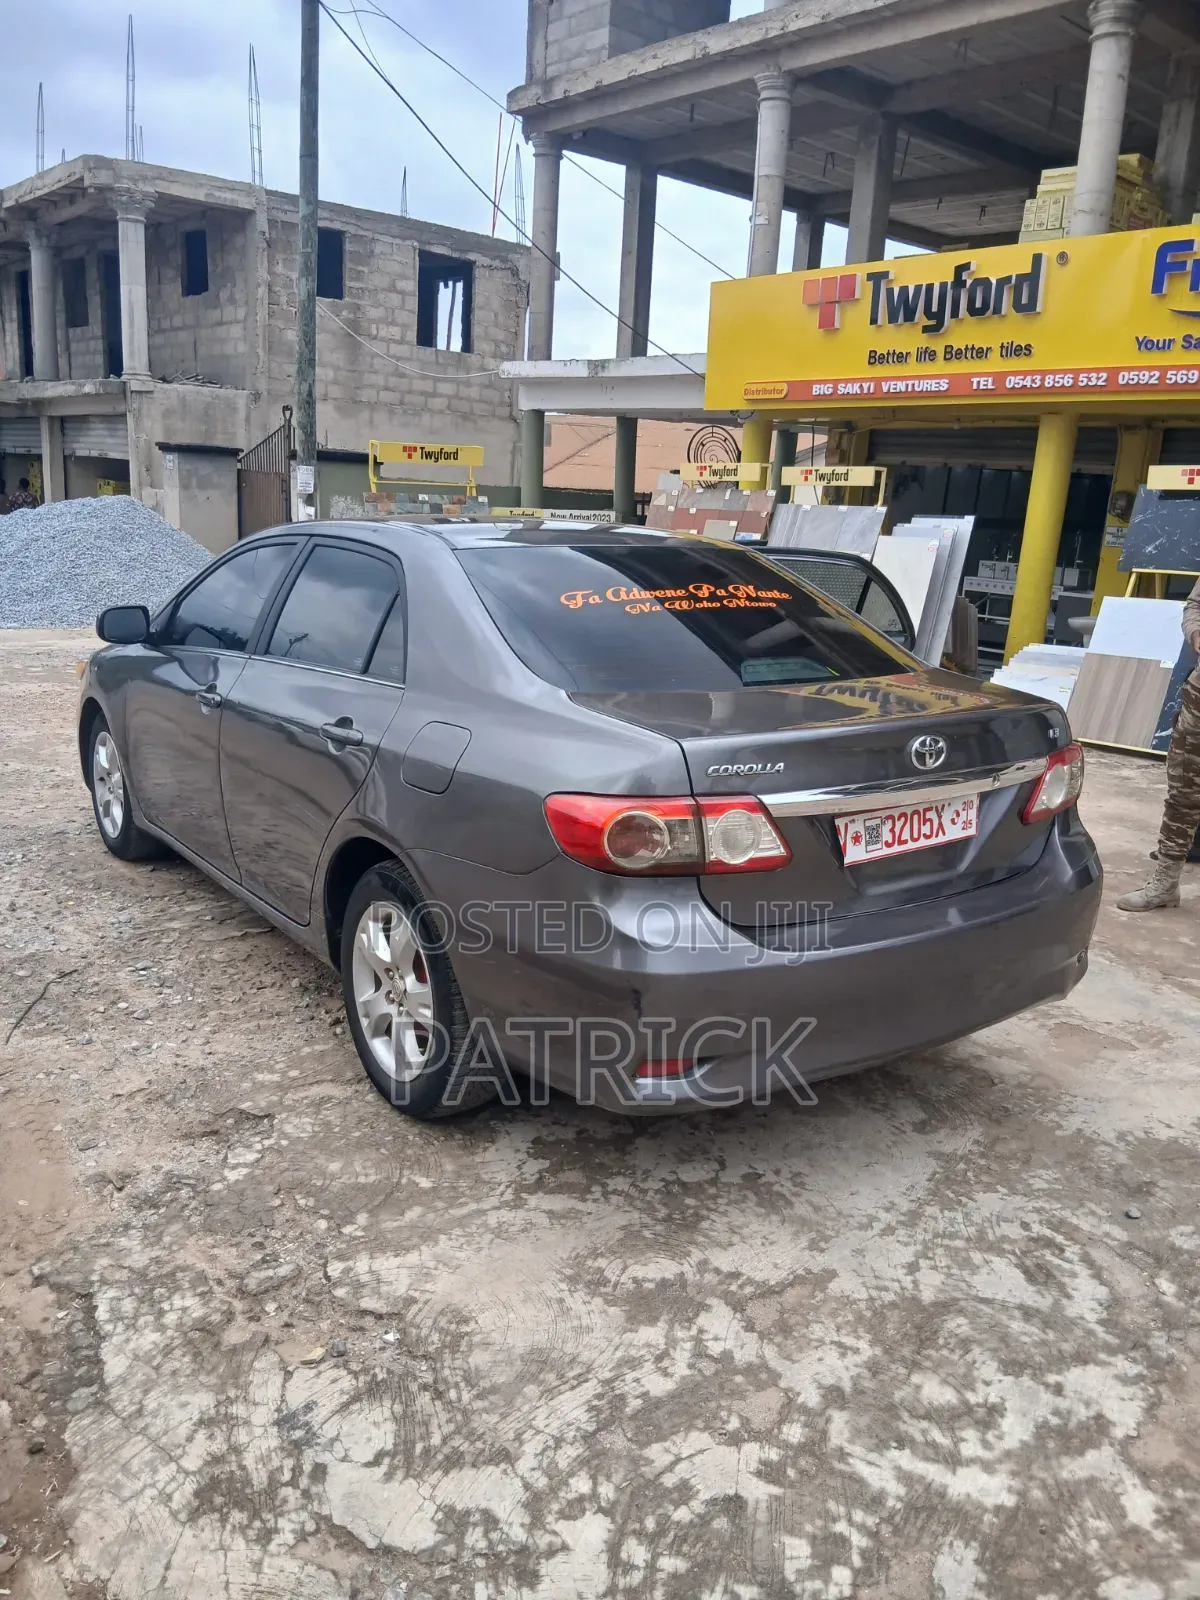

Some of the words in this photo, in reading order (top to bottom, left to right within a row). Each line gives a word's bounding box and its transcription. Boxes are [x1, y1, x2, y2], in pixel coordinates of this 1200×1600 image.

[866, 252, 1048, 334] Twyford
[1135, 335, 1176, 351] Your
[868, 349, 911, 366] Better
[916, 346, 937, 363] life
[943, 344, 992, 361] Better
[999, 340, 1033, 358] tiles
[812, 384, 834, 396] BIG
[837, 382, 875, 395] SAKYI
[881, 379, 949, 393] VENTURES
[970, 377, 996, 390] TEL
[1005, 375, 1041, 389] 0543
[1044, 374, 1074, 388] 856
[1078, 372, 1108, 387] 532
[1118, 371, 1160, 385] 0592
[1165, 369, 1199, 384] 569
[743, 385, 785, 397] Distributor
[420, 447, 459, 463] Twyford
[708, 464, 738, 480] Twyford
[814, 469, 849, 485] Twyford
[688, 583, 729, 598] Pa
[728, 584, 793, 600] Nante
[624, 602, 662, 615] Na
[664, 599, 721, 611] Woho
[706, 762, 785, 777] COROLLA
[884, 803, 946, 849] 3205X
